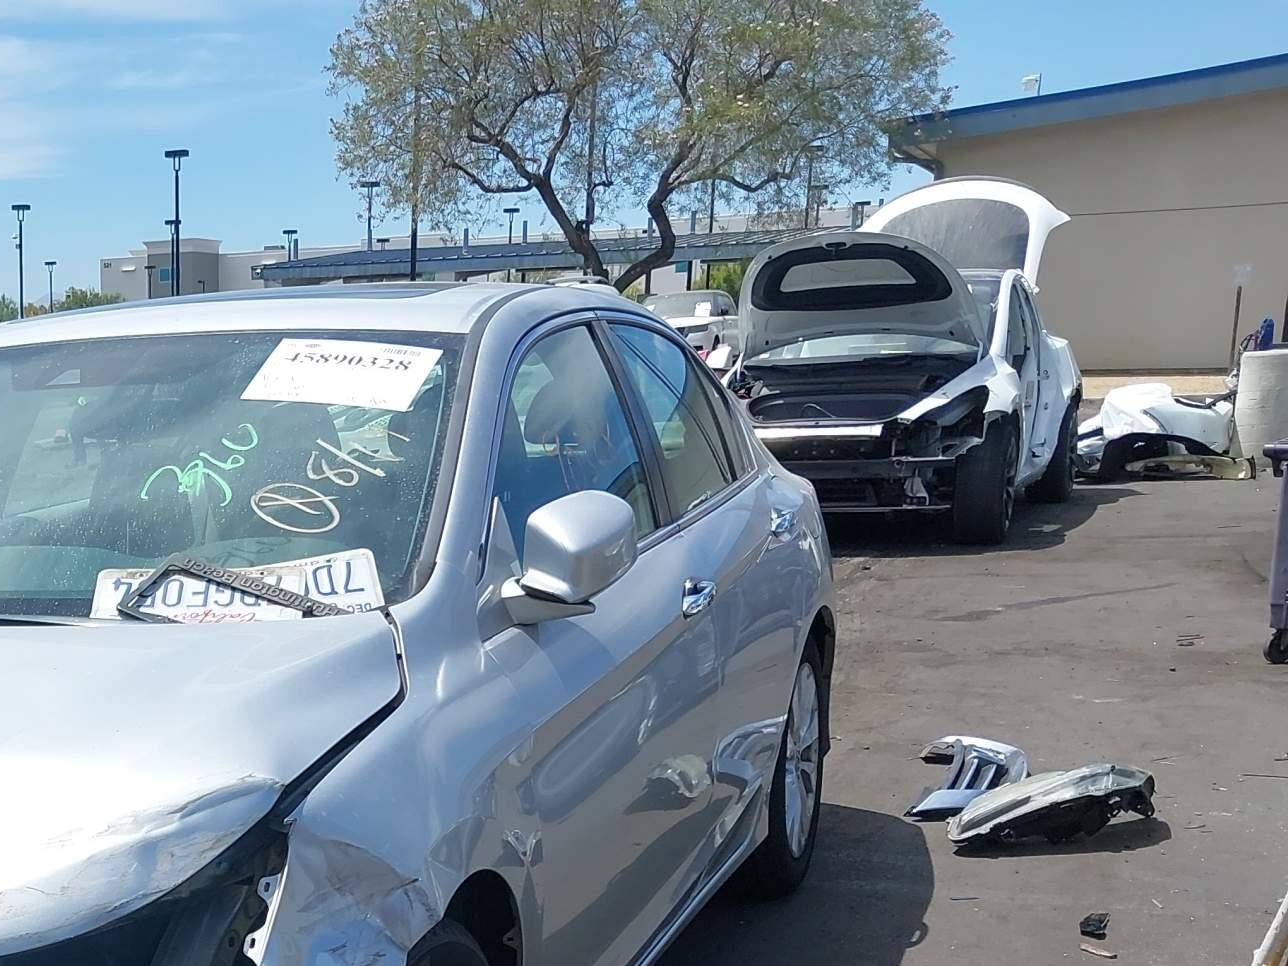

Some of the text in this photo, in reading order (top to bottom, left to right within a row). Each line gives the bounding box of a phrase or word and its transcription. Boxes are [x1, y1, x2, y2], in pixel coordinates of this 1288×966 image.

[283, 351, 413, 372] 45890328
[183, 558, 339, 617] Huntington Beach
